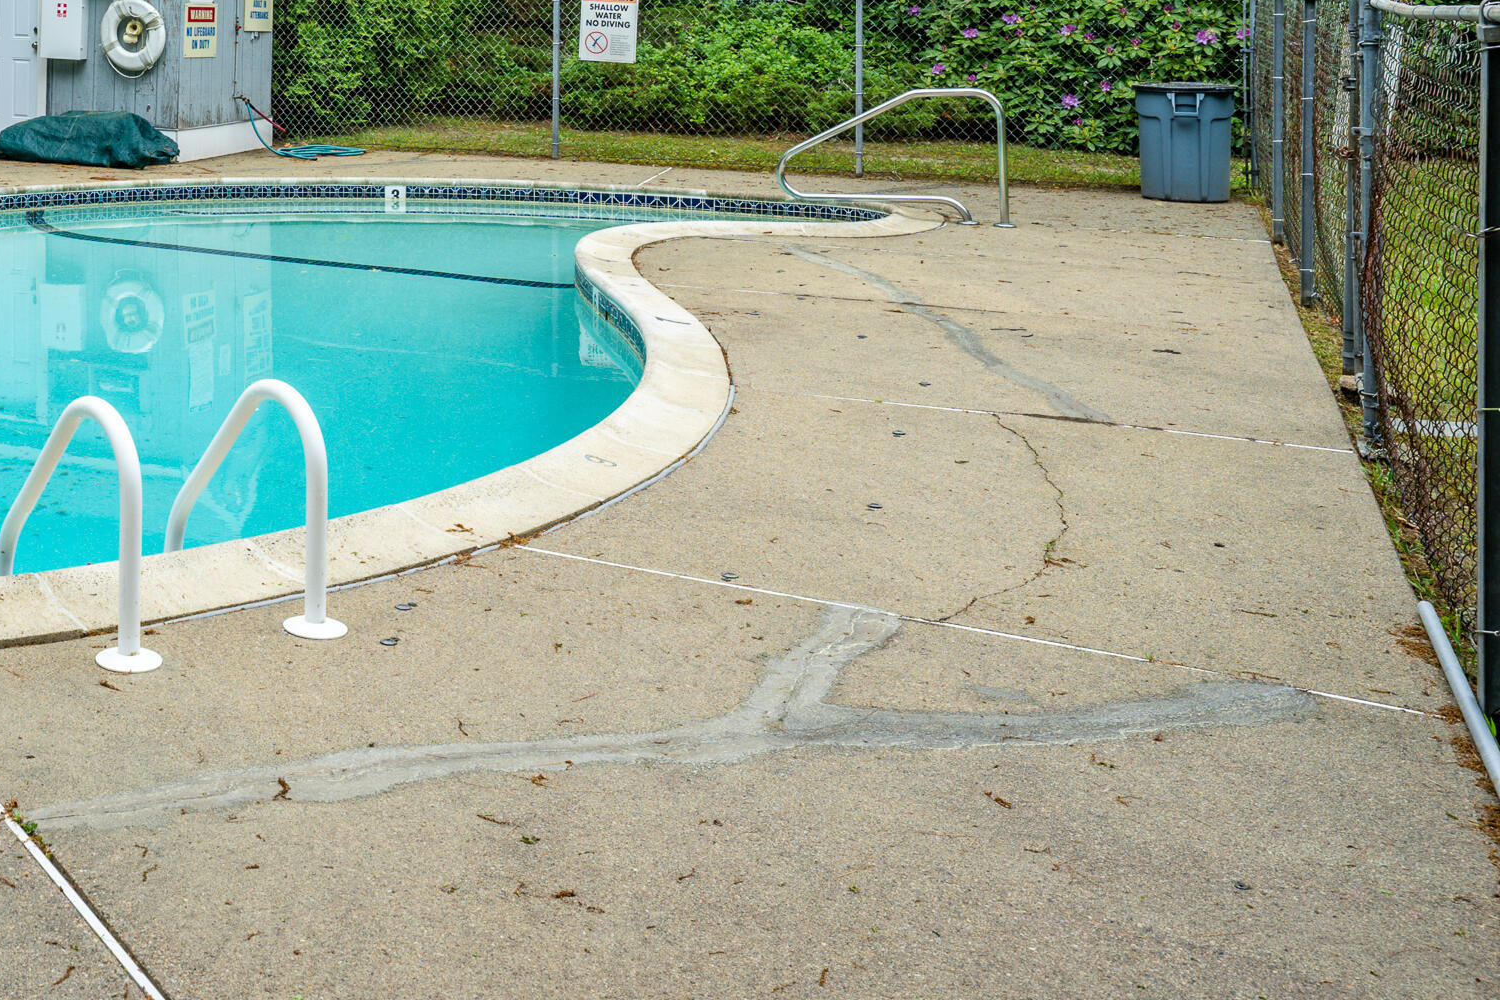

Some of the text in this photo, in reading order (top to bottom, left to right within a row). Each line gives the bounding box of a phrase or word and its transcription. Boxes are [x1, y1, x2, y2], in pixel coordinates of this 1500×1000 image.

[590, 3, 629, 11] SHALLOW
[190, 9, 213, 20] WARNING
[250, 11, 268, 19] ATTENDANCE
[601, 20, 631, 28] DIVING
[186, 26, 215, 36] NO LIFEGUARD
[192, 39, 210, 49] ON DUTY
[391, 189, 400, 199] 3
